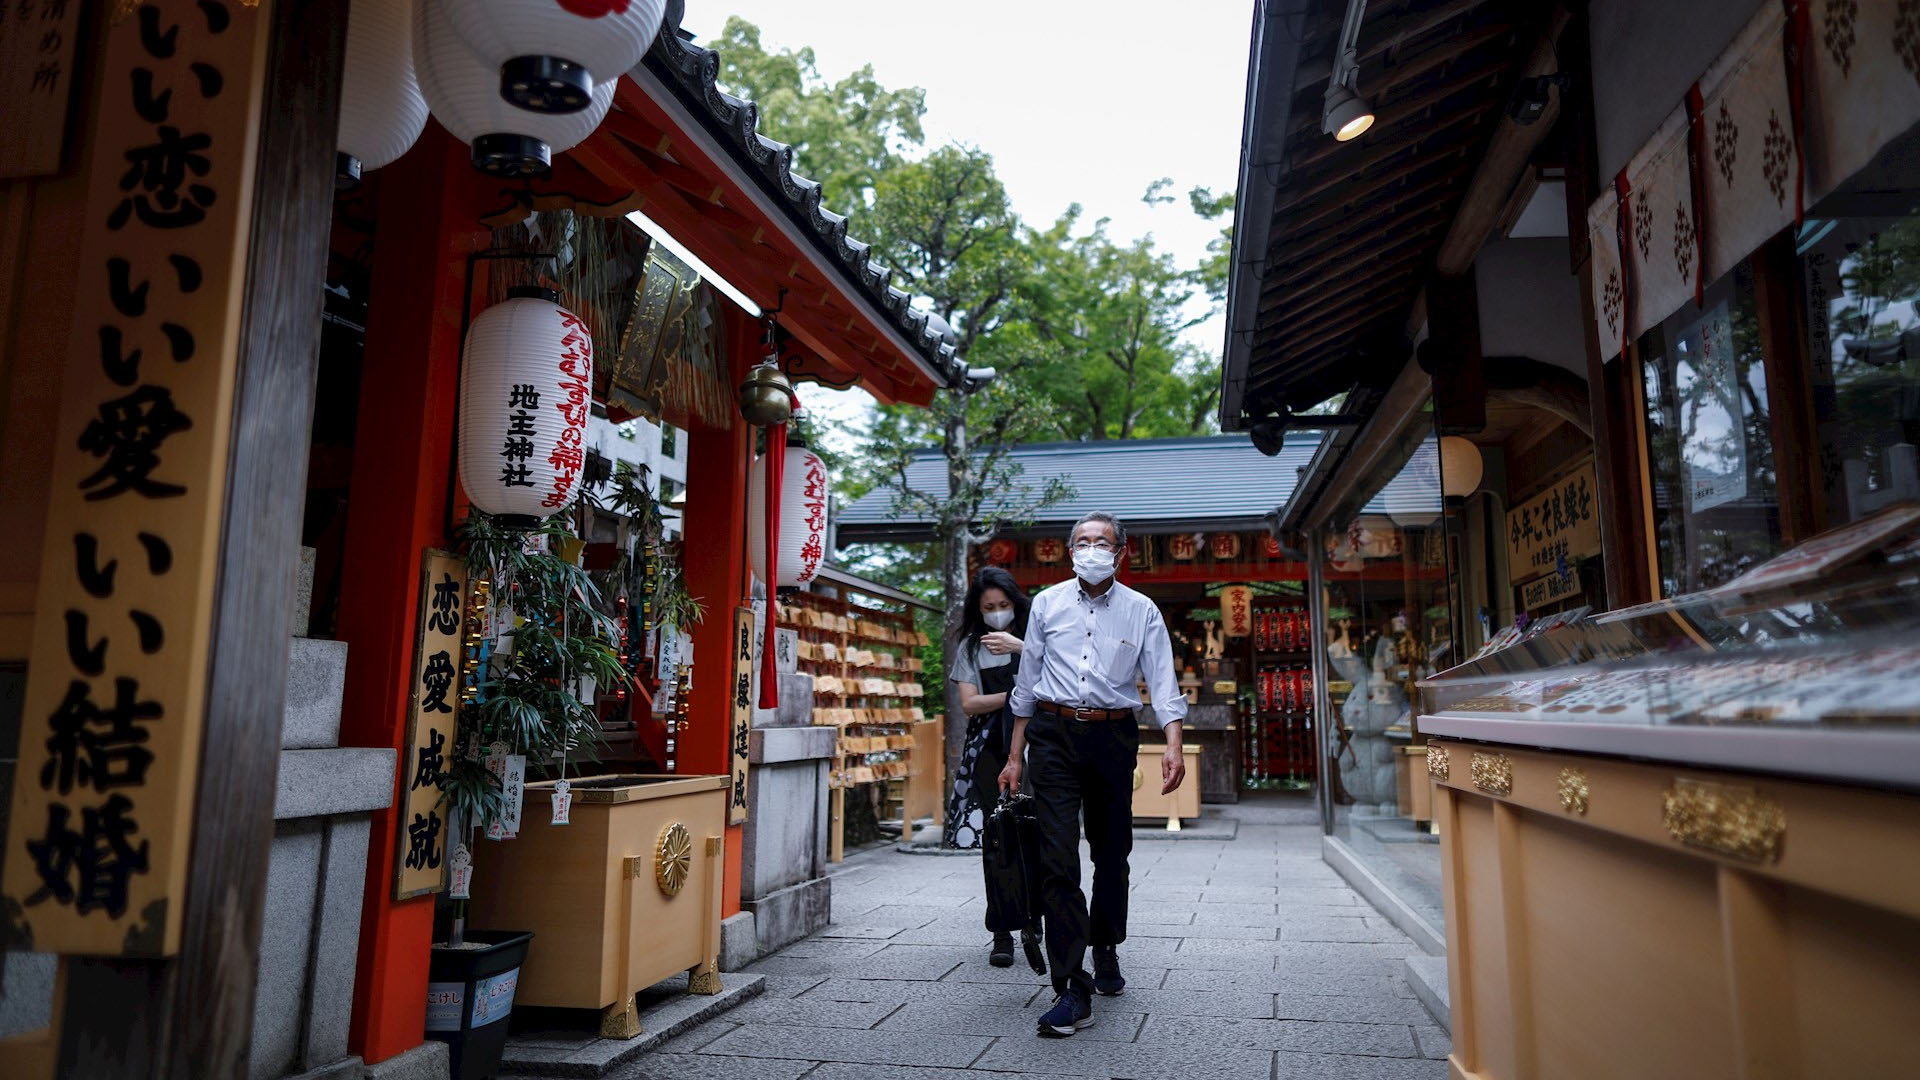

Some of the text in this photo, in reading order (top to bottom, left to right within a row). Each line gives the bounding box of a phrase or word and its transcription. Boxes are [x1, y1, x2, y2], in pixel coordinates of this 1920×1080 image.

[24, 3, 230, 920] いい恋いい愛いい結婚
[499, 384, 541, 488] 地主神社
[1230, 589, 1246, 635] 家内安全
[404, 572, 460, 871] 恋愛成就
[731, 622, 751, 809] 良縁達成
